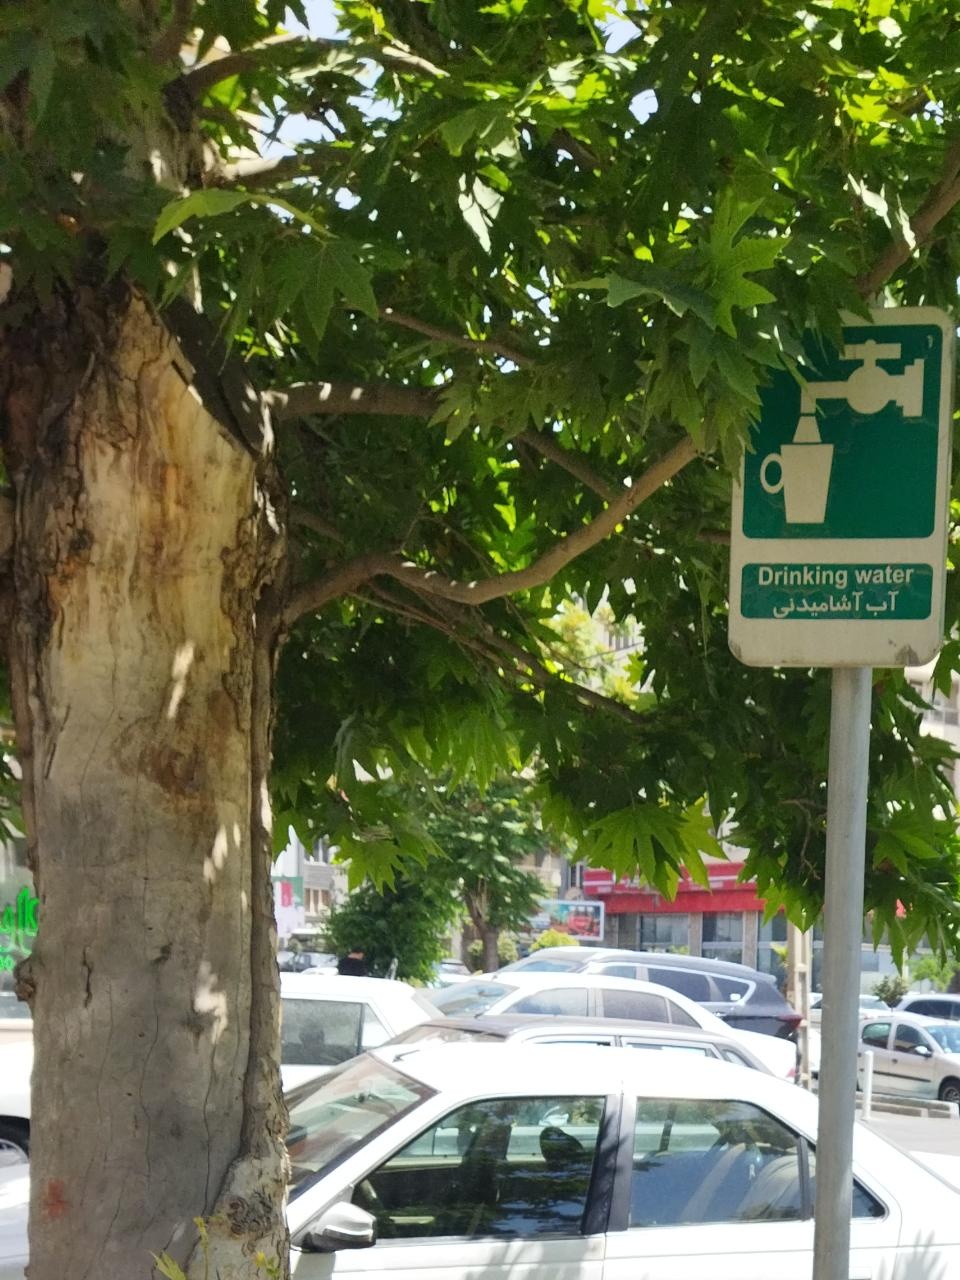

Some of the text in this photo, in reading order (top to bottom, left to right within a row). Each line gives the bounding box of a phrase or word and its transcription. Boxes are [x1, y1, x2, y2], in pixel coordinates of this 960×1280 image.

[758, 565, 914, 589] Drinking water
[772, 590, 899, 618] آب آشامیدنی
